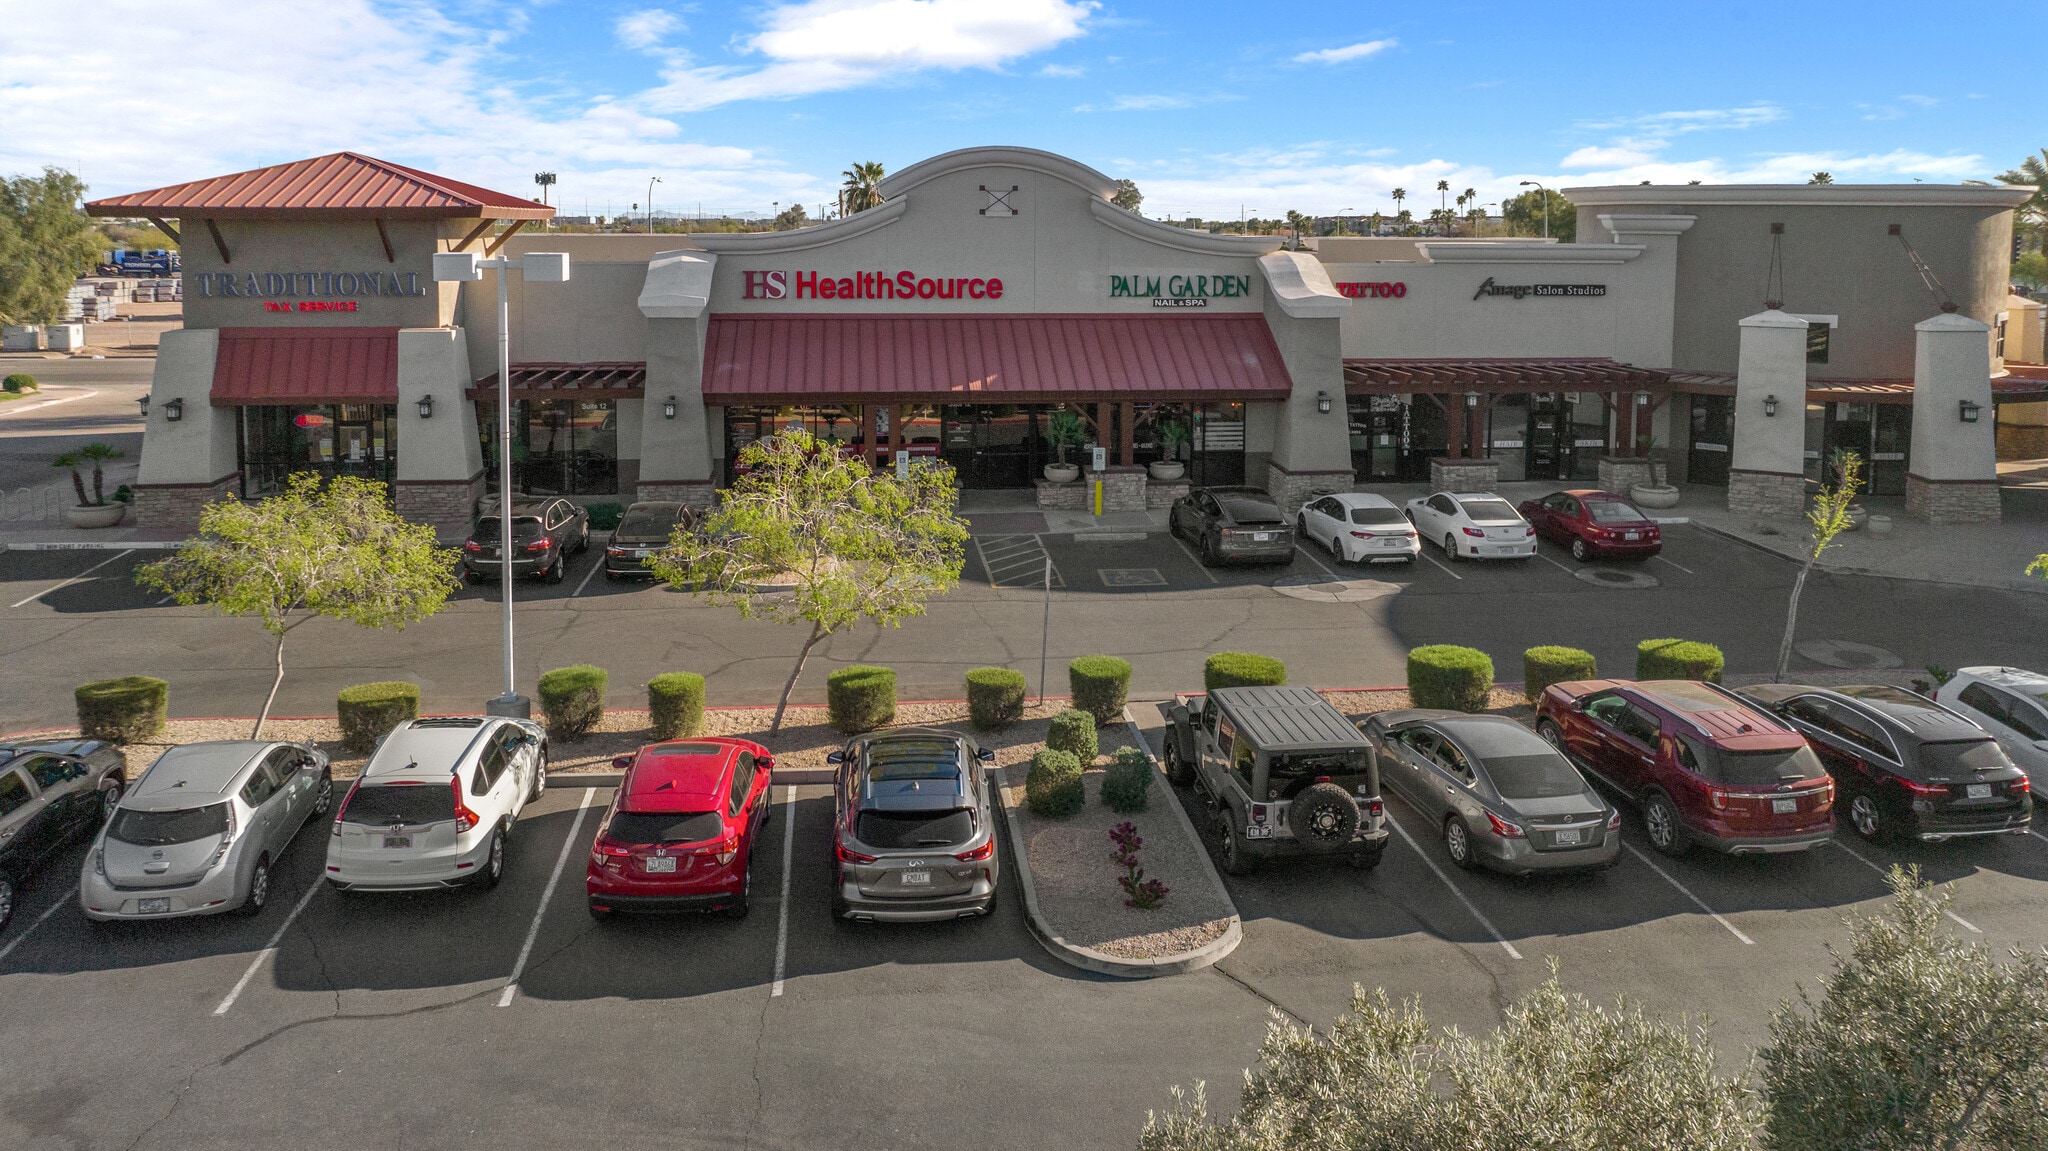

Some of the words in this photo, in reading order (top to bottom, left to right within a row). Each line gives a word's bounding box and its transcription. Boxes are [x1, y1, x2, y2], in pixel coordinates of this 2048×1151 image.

[194, 271, 426, 297] TRADITIONAL
[742, 271, 787, 299] HS
[796, 271, 1004, 299] HealthSource
[1110, 275, 1161, 297] PALM
[1168, 275, 1250, 297] GARDEN
[1336, 282, 1407, 298] TATTOO
[1536, 285, 1564, 295] Salon
[1567, 285, 1605, 295] Studios
[263, 301, 293, 312] TAX
[298, 301, 358, 312] SERVICE
[1403, 404, 1411, 444] TATTOO
